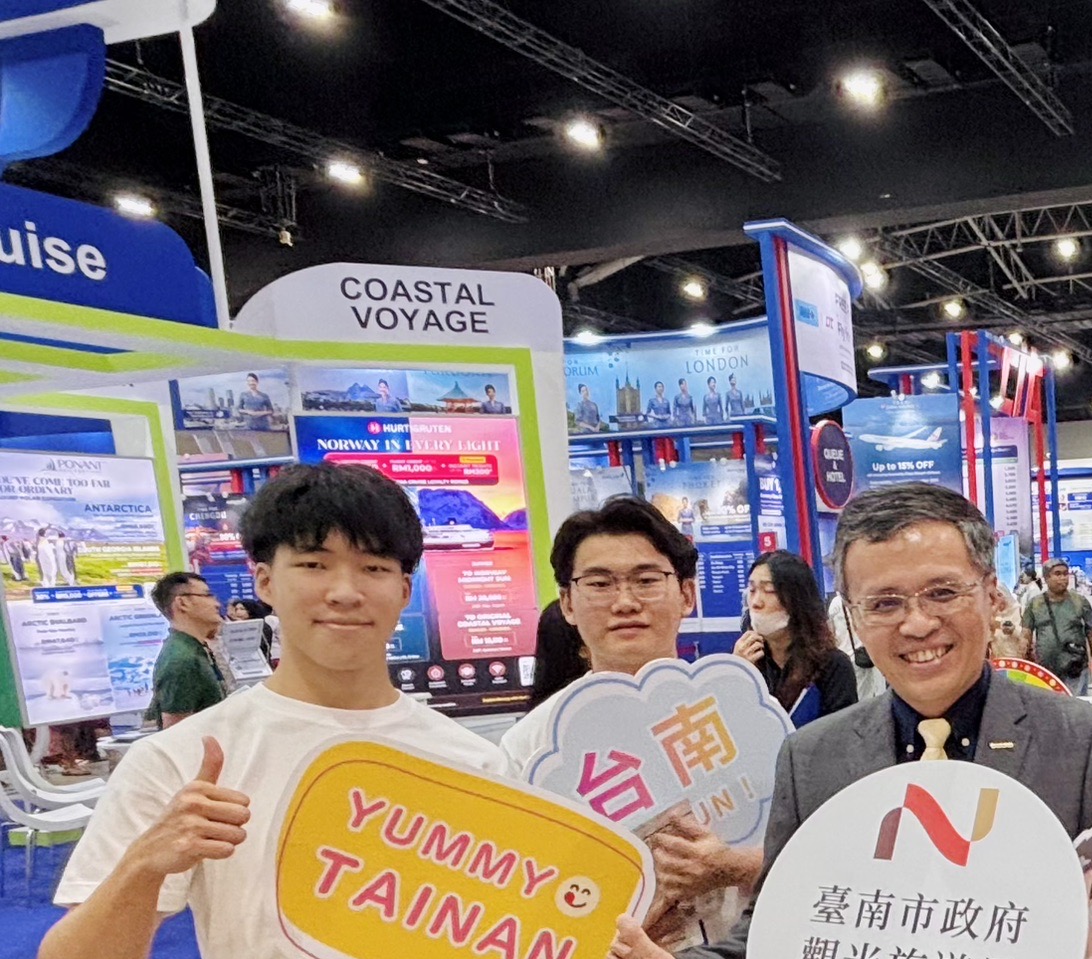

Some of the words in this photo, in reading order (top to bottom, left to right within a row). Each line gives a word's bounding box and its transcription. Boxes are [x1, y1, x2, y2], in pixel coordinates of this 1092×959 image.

[340, 276, 495, 307] COASTAL
[350, 306, 490, 333] VOYAGE
[685, 354, 749, 374] LONDON
[317, 439, 380, 451] NORWAY
[385, 439, 400, 450] IN
[405, 439, 453, 451] EVERY
[458, 440, 502, 451] LIGHT
[872, 463, 885, 473] Up
[887, 462, 896, 471] to
[898, 461, 914, 470] 15%
[915, 460, 935, 470] OFF
[85, 503, 152, 513] ANTARCTICA
[693, 776, 755, 827] UN!
[349, 789, 557, 897] YUMMY
[809, 884, 1030, 945] 臺南市政府
